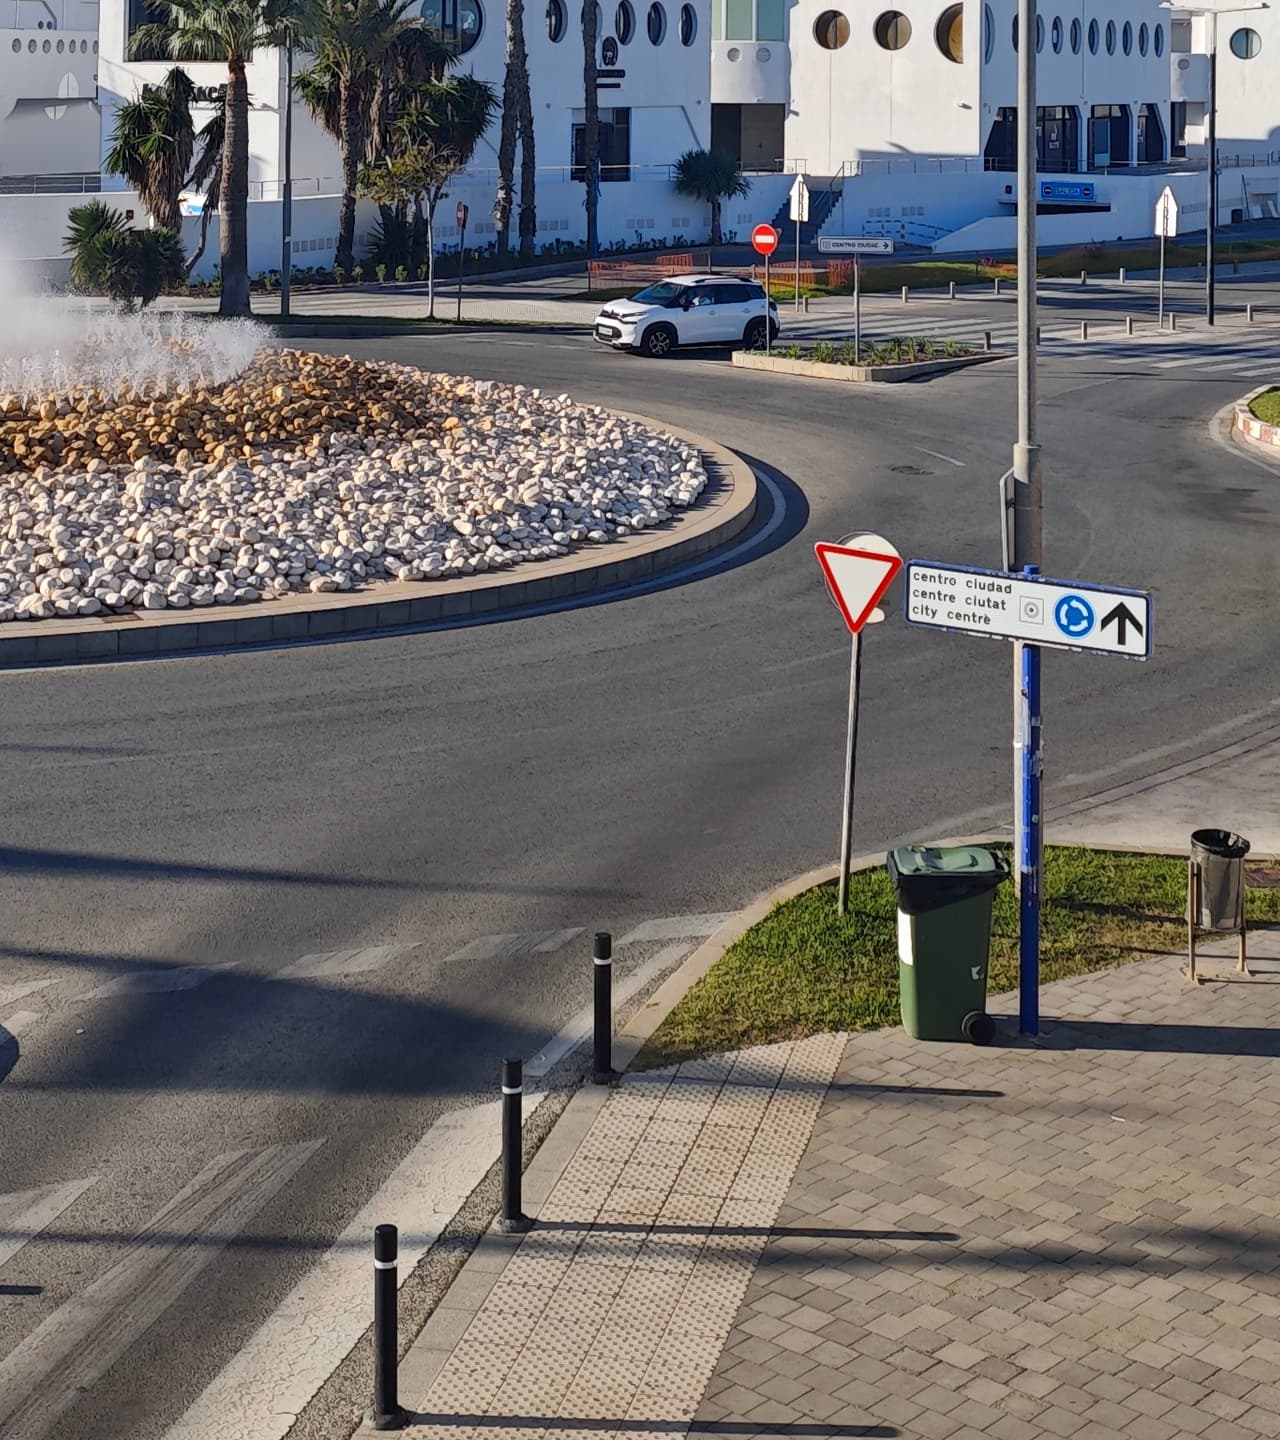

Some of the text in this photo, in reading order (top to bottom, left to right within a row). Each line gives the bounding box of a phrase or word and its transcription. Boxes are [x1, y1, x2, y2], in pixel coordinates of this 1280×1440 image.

[913, 572, 1012, 594] centro ciudad
[912, 589, 1007, 610] centre ciutat
[912, 604, 938, 619] city
